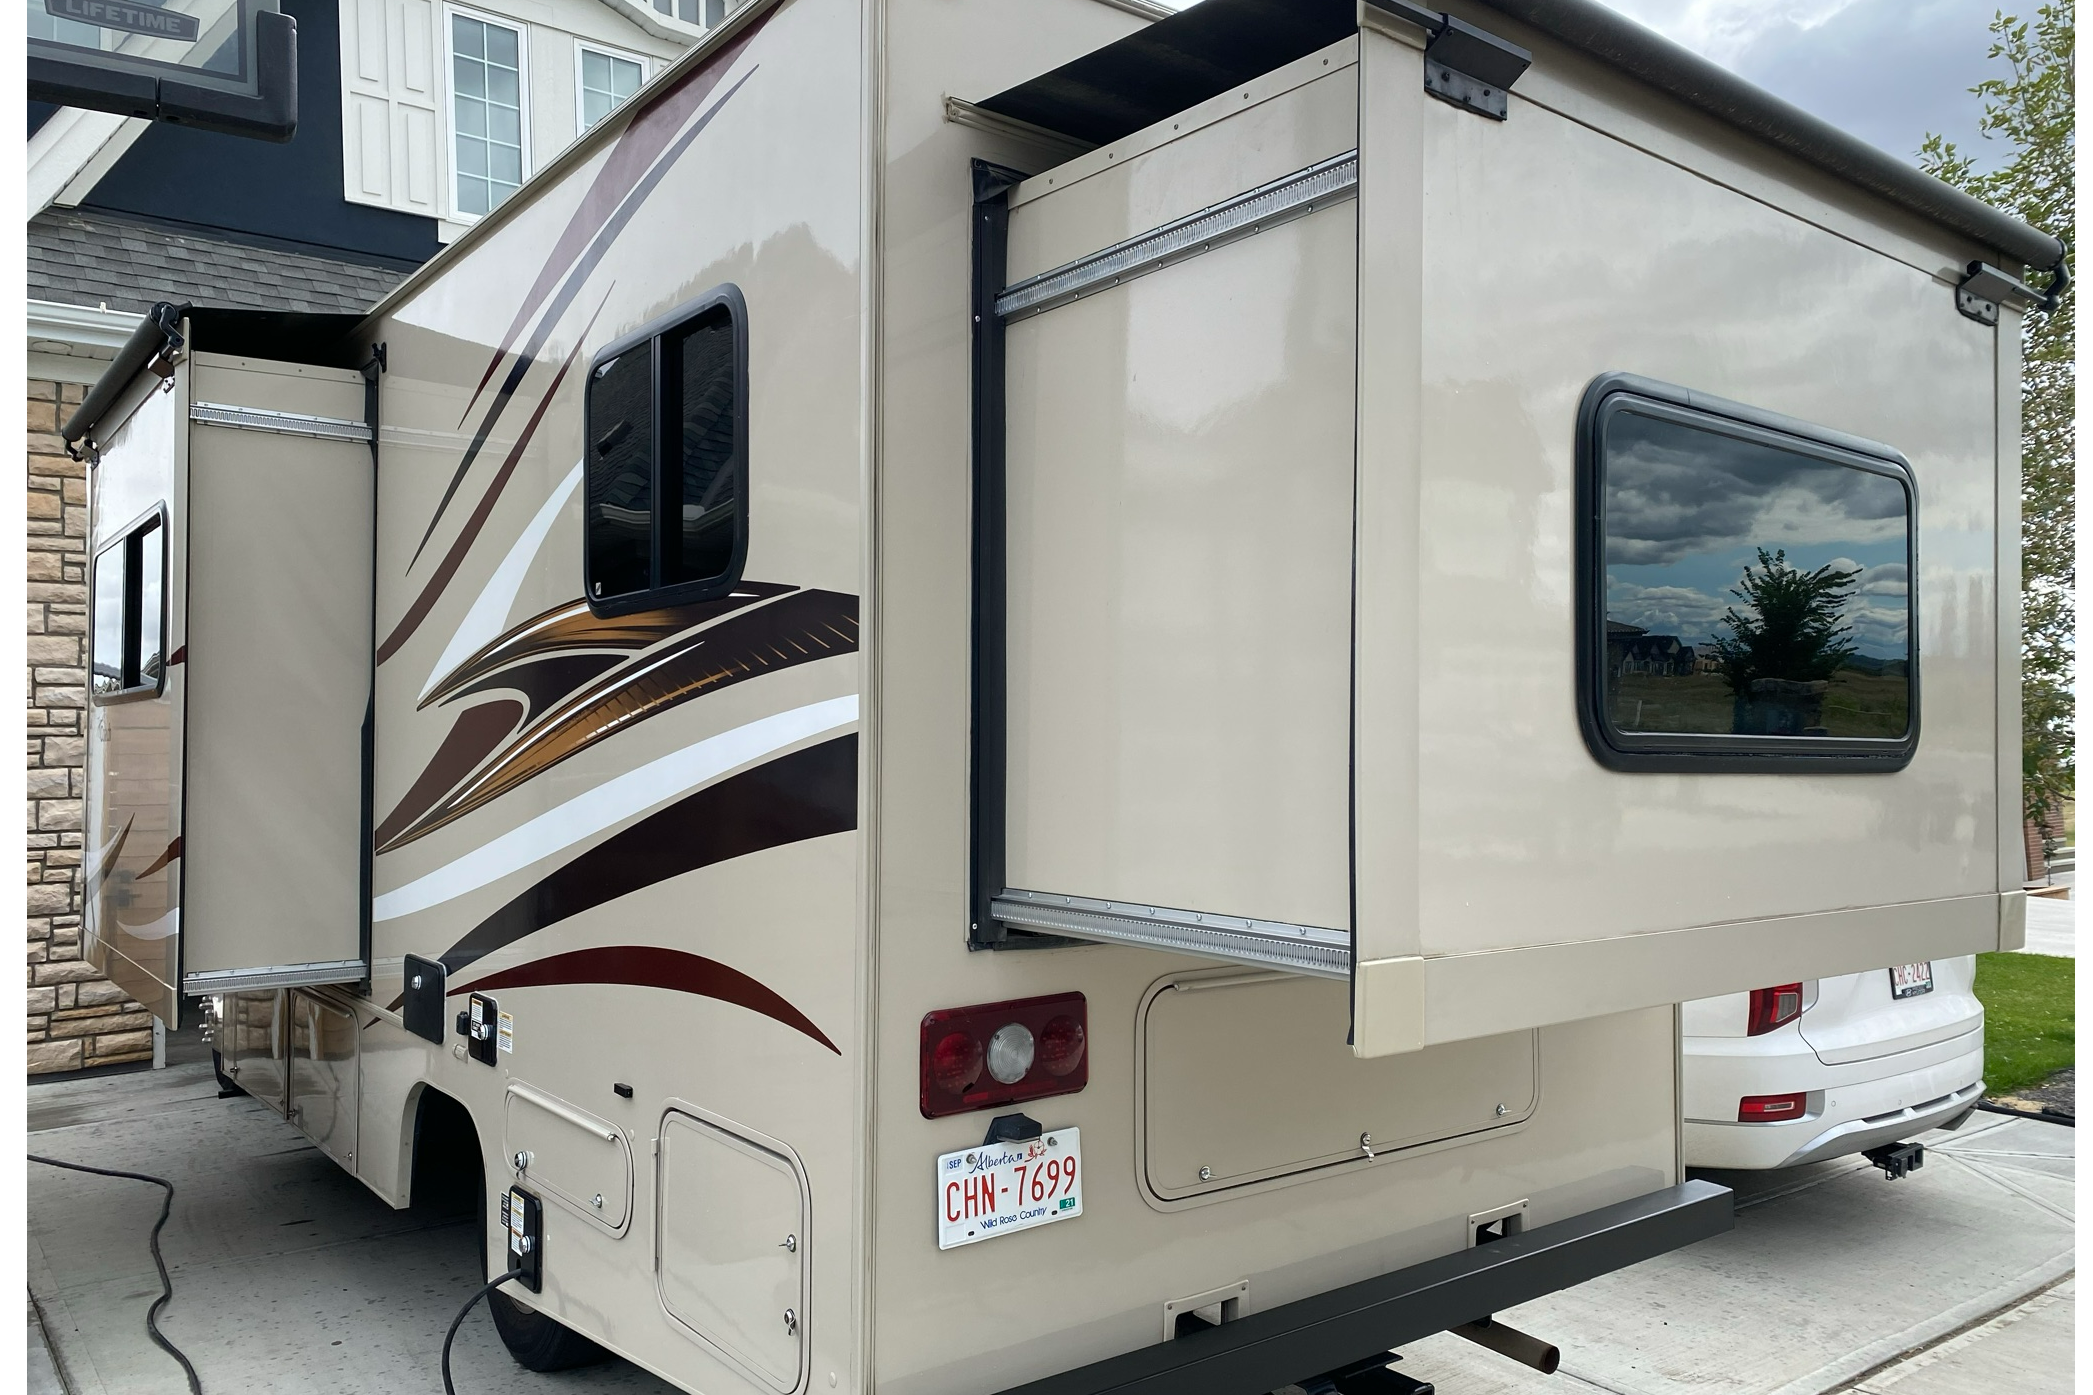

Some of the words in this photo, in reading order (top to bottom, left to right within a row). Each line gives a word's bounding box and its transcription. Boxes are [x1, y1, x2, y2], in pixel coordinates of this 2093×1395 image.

[65, 0, 181, 33] LIFETIME
[949, 1158, 962, 1170] SEP
[969, 1151, 1018, 1174] Alberta
[946, 1155, 1076, 1222] CHN-7699
[1065, 1198, 1074, 1208] 21
[980, 1216, 998, 1230] Wild
[999, 1215, 1018, 1226] Rose
[1019, 1206, 1048, 1220] Country
